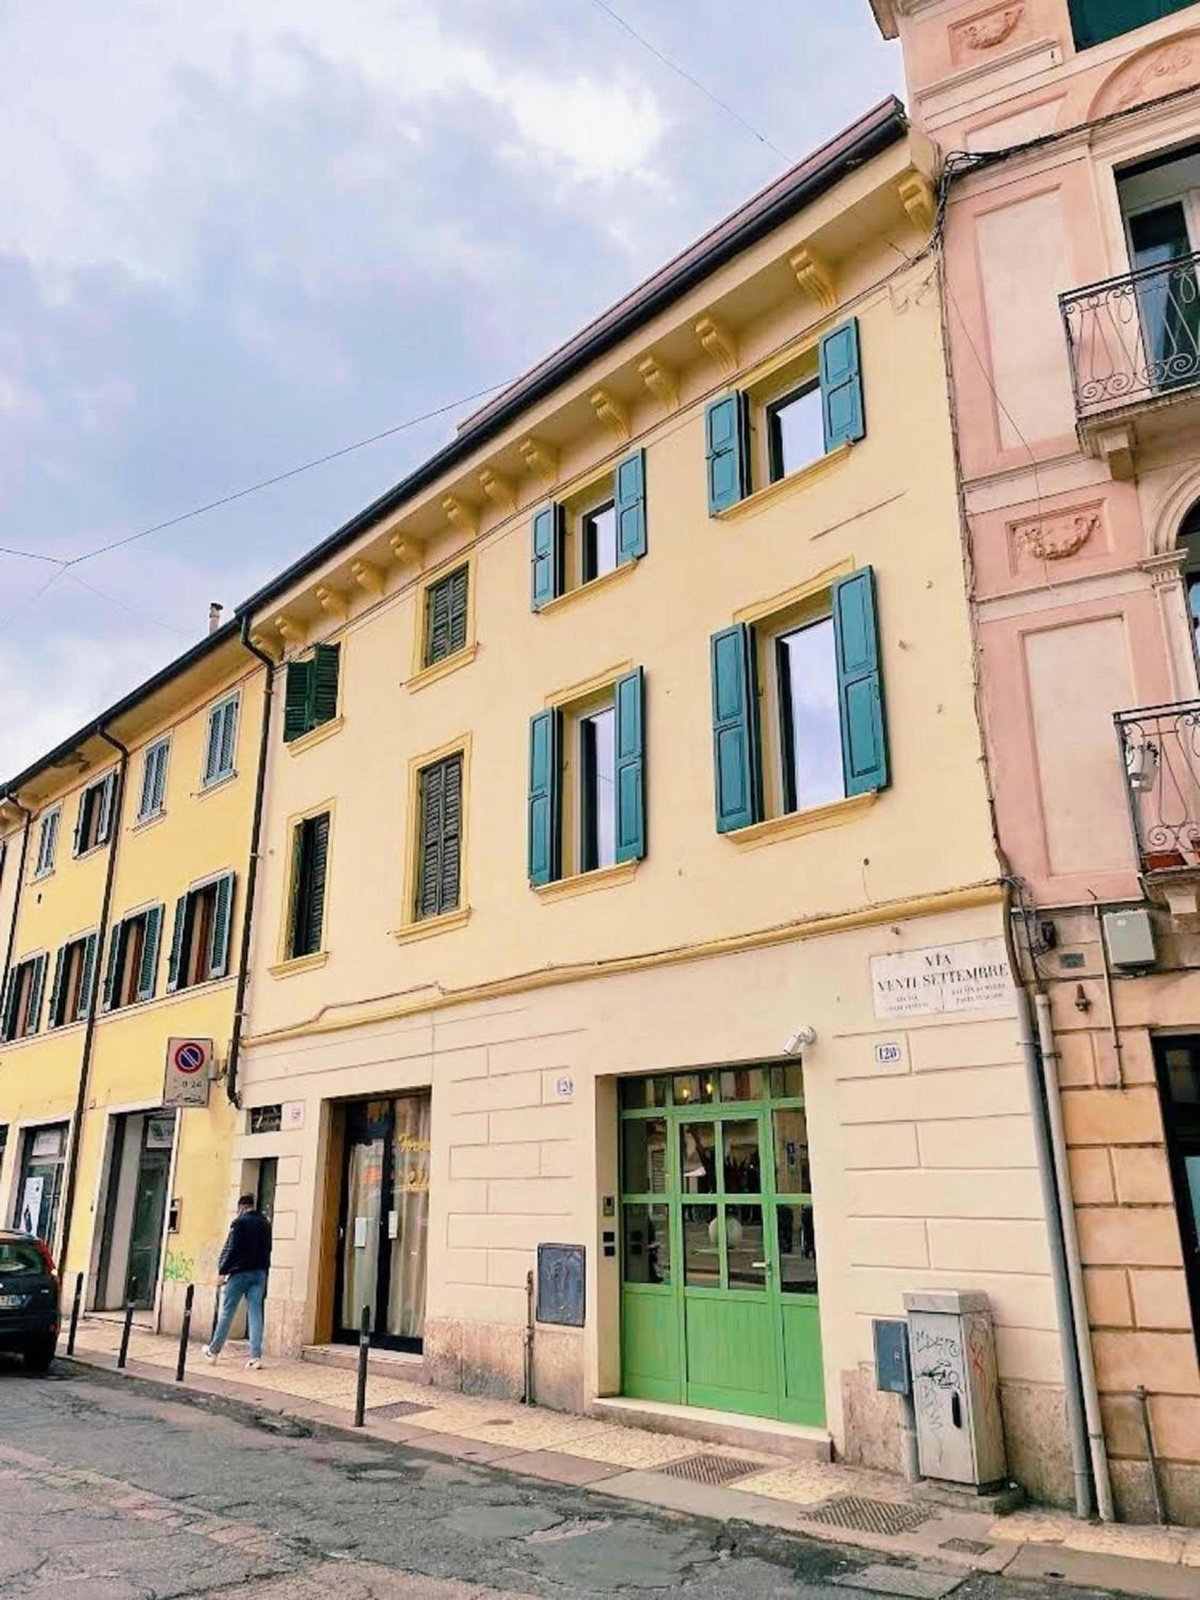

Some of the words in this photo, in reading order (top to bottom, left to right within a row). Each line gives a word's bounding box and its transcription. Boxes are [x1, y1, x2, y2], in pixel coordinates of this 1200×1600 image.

[925, 953, 952, 967] VIA
[877, 976, 916, 992] VENTI
[922, 964, 1008, 986] SETTEMBRE
